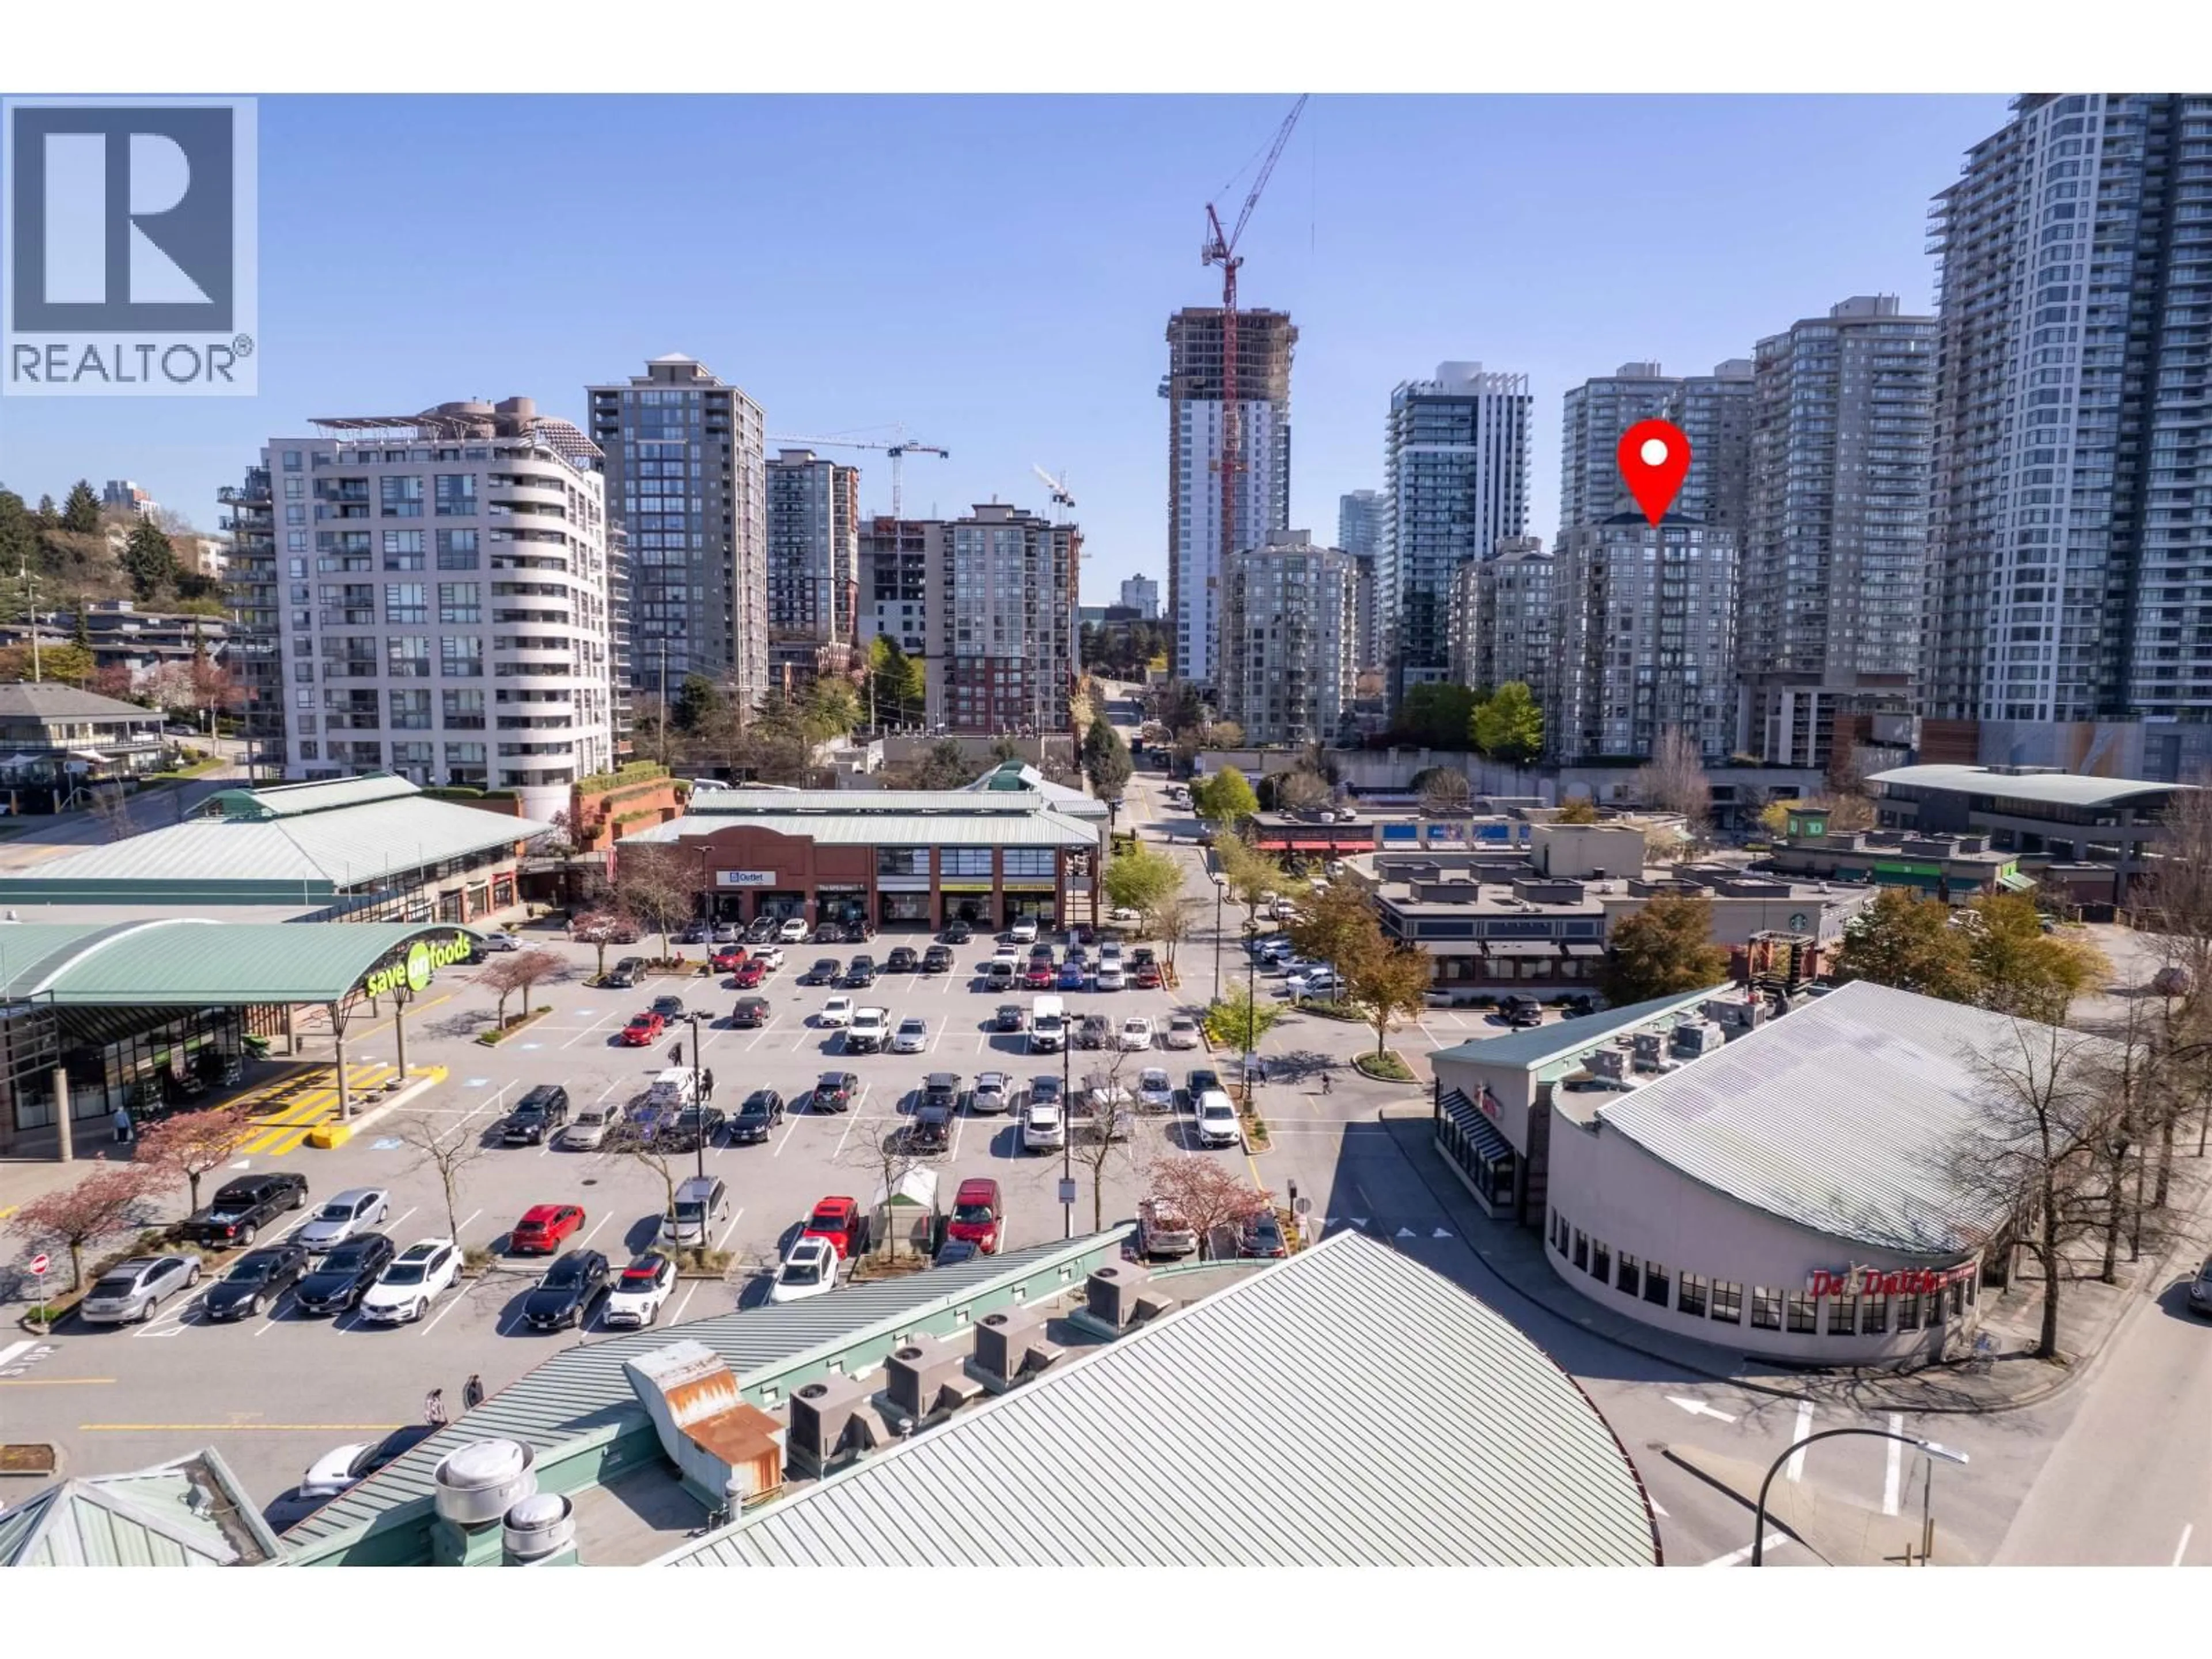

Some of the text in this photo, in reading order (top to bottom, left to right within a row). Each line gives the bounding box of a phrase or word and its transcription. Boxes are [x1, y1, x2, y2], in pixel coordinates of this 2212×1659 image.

[740, 873, 764, 881] Outlet
[367, 930, 471, 998] save on foods
[1809, 1270, 1843, 1296] De
[1863, 1266, 1939, 1296] Dutch
